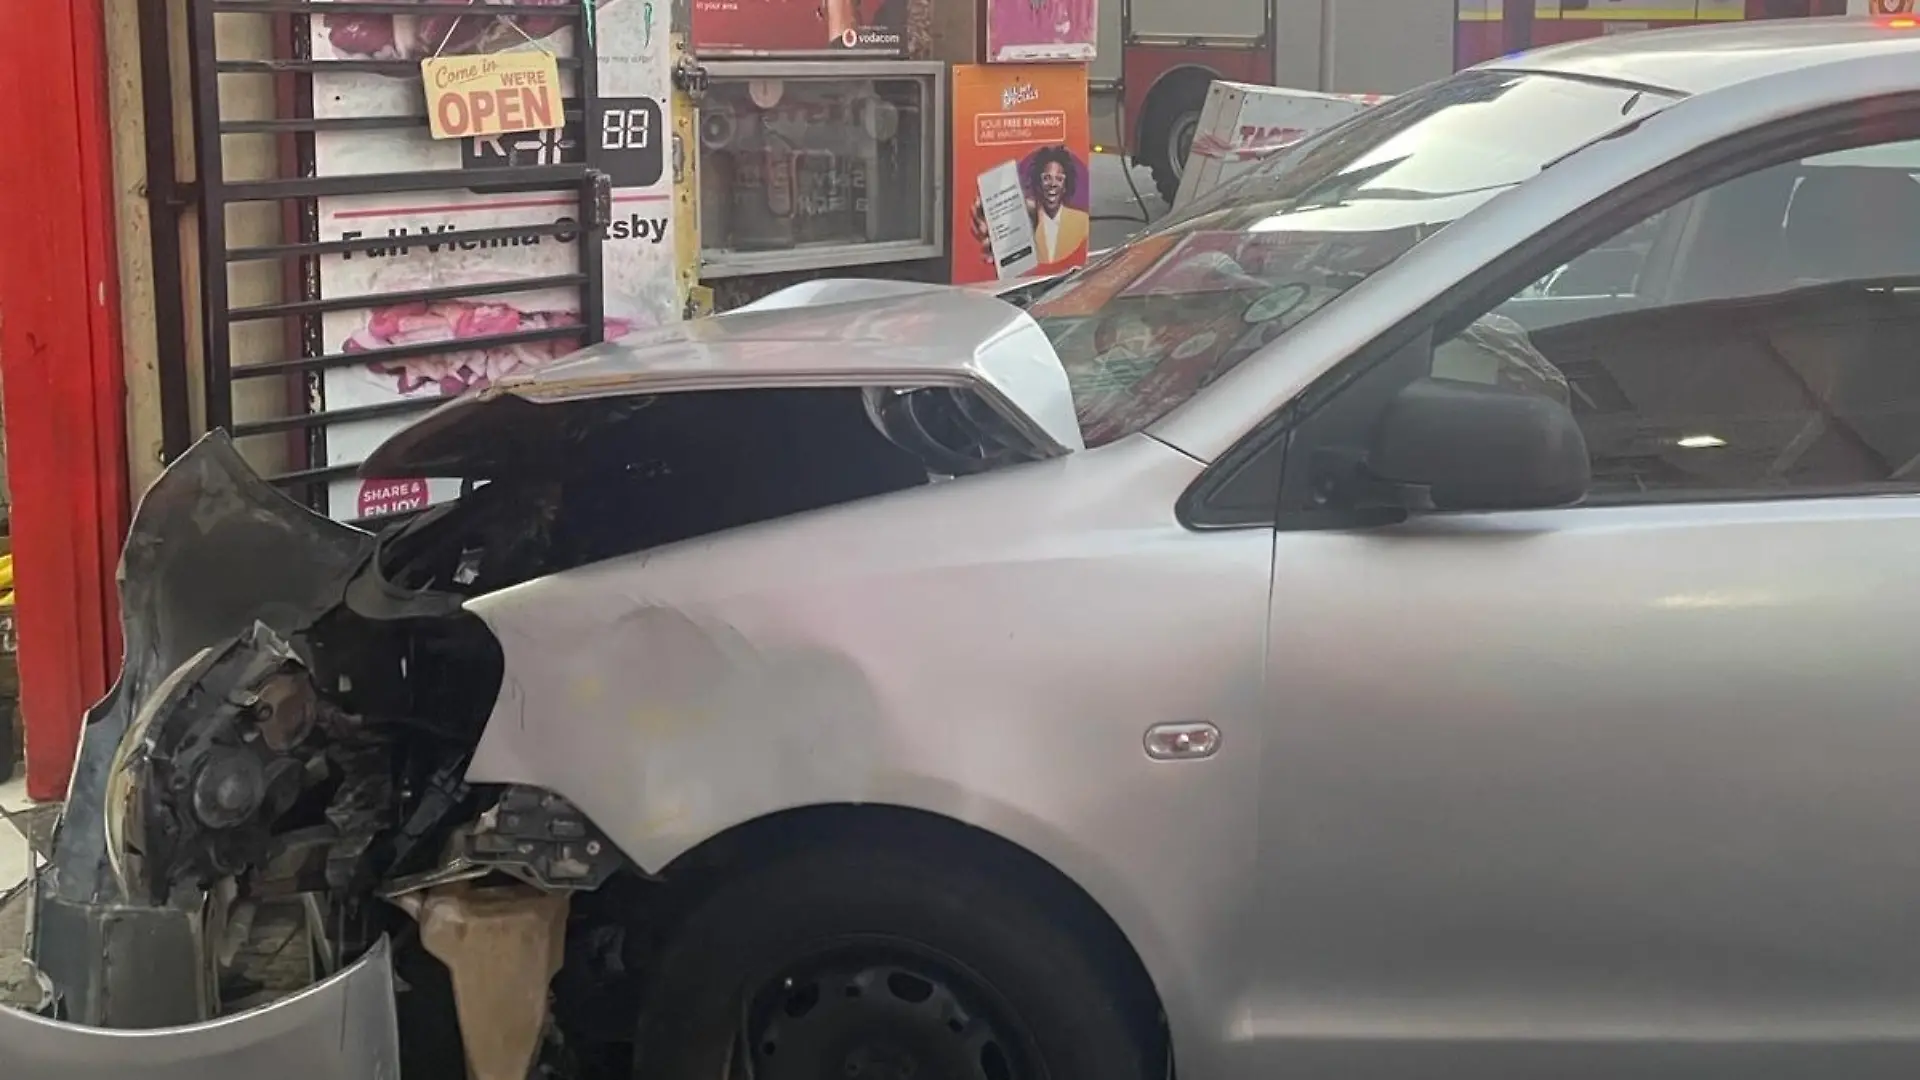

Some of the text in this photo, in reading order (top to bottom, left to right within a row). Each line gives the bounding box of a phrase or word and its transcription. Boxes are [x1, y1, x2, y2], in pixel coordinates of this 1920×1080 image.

[859, 33, 899, 43] vodacom
[435, 58, 497, 88] Come in
[500, 70, 546, 87] WE'RE
[438, 86, 553, 135] OPEN
[1003, 117, 1021, 128] FREE
[1022, 116, 1060, 127] REWARDS
[364, 482, 421, 502] SHARE &
